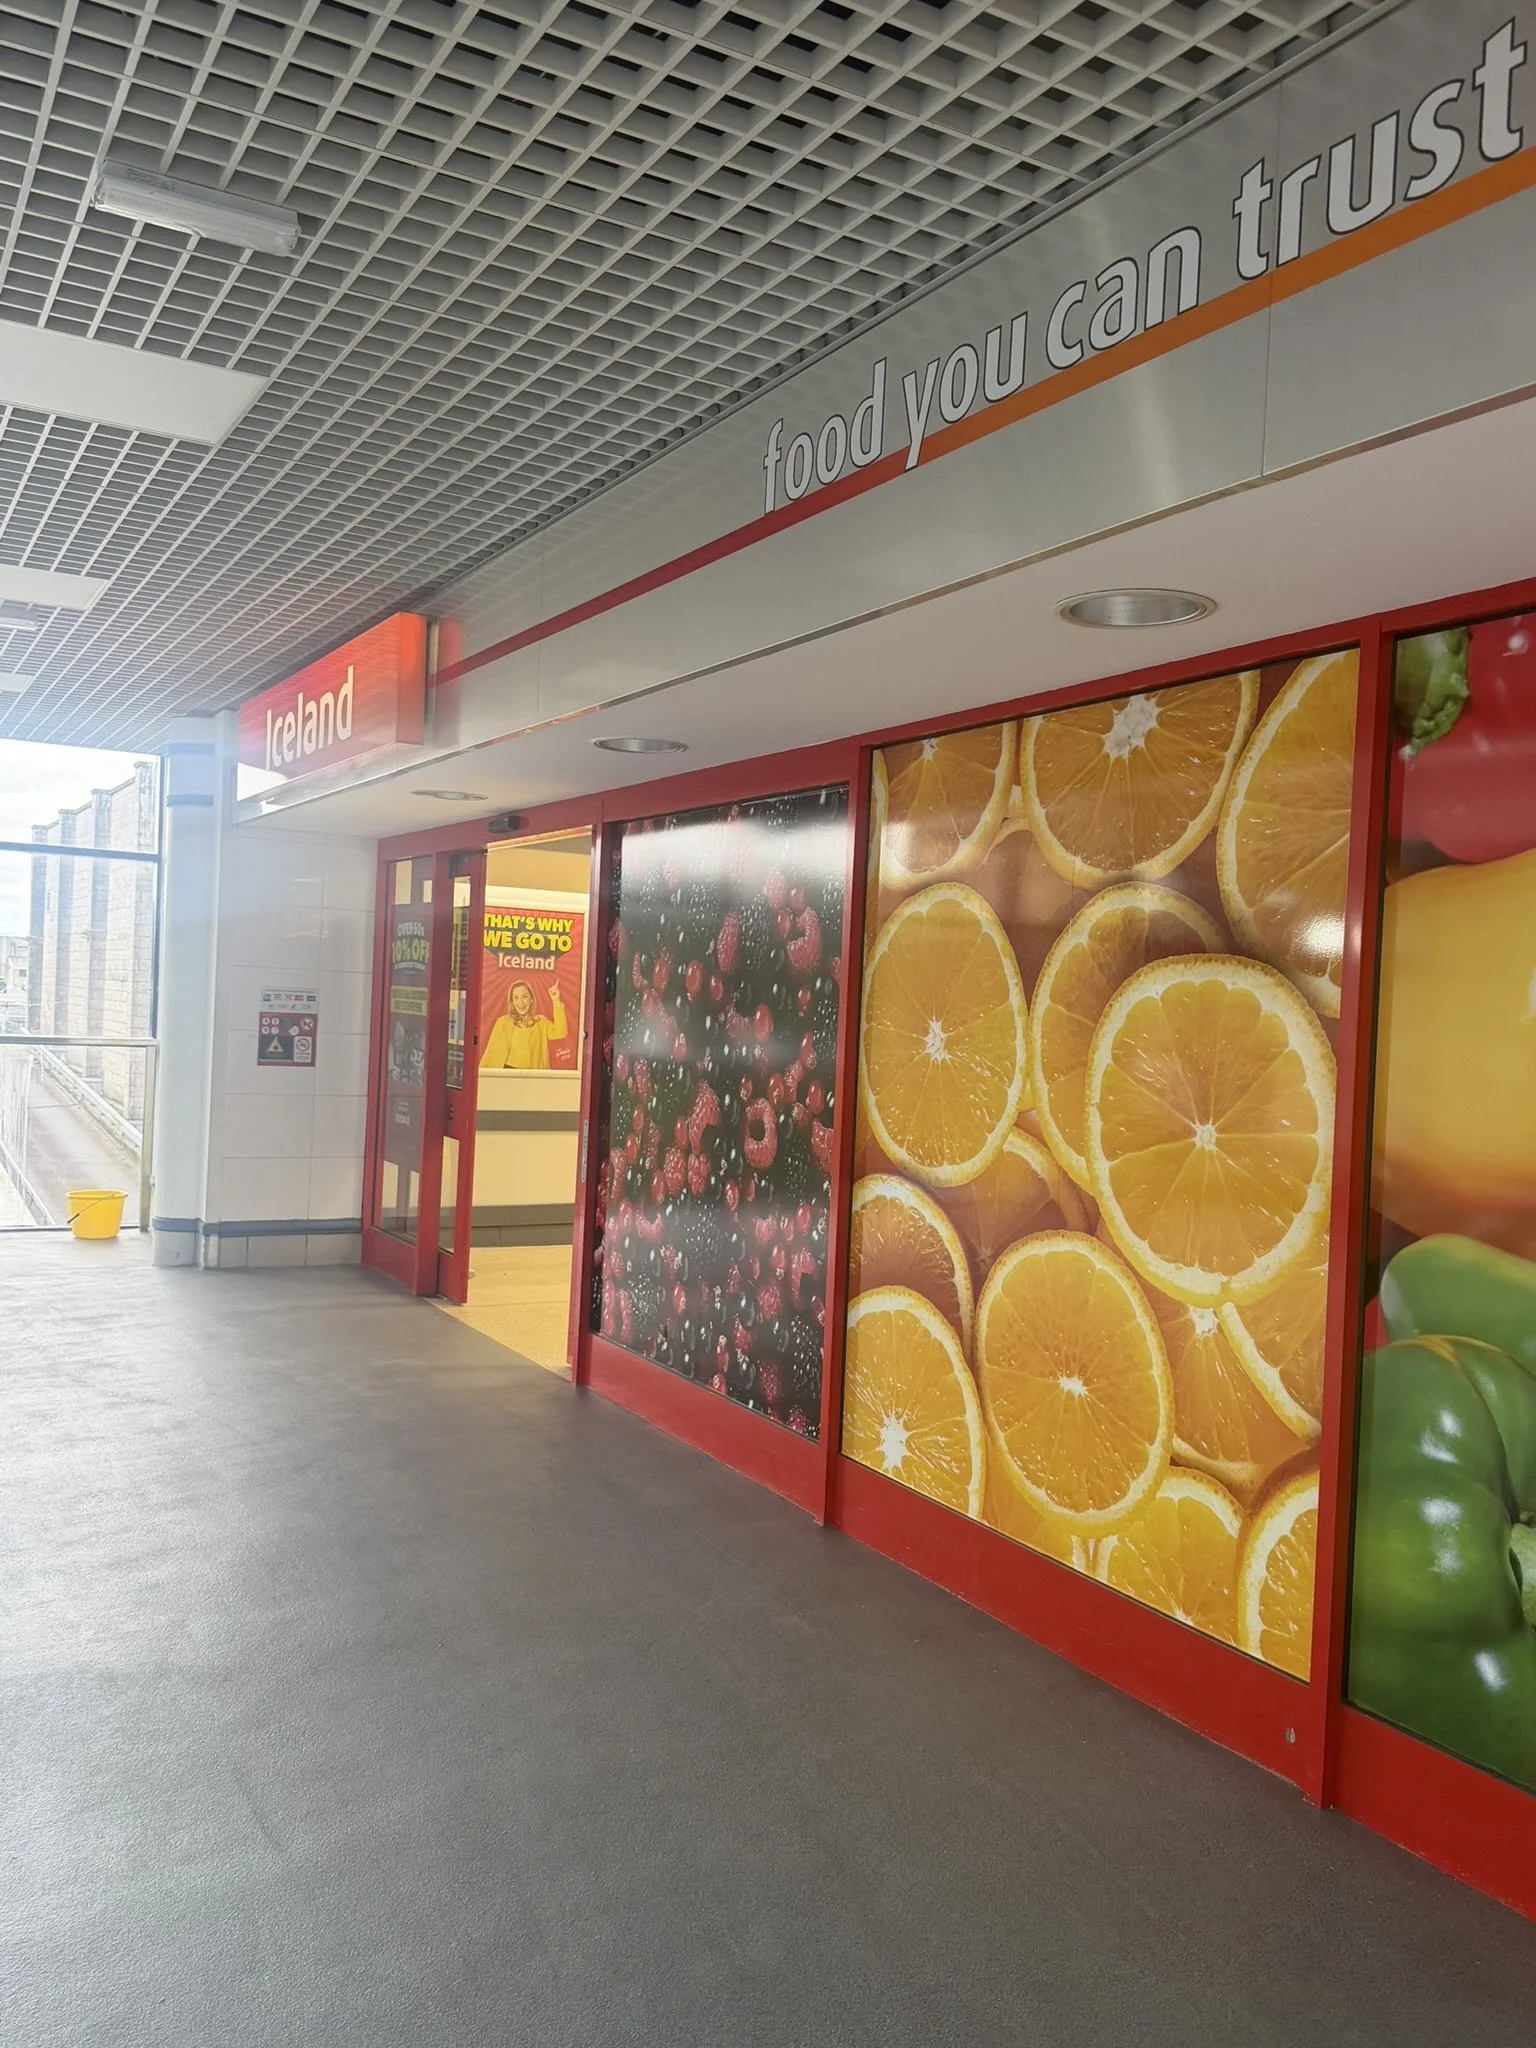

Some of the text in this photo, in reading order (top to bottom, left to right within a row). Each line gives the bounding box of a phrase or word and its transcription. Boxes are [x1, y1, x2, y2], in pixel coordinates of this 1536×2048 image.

[763, 17, 1529, 515] food you can trust
[265, 664, 354, 771] Iceland
[484, 912, 574, 933] THAT'S WHY
[483, 929, 573, 952] WE GO TO
[498, 952, 555, 970] Iceland
